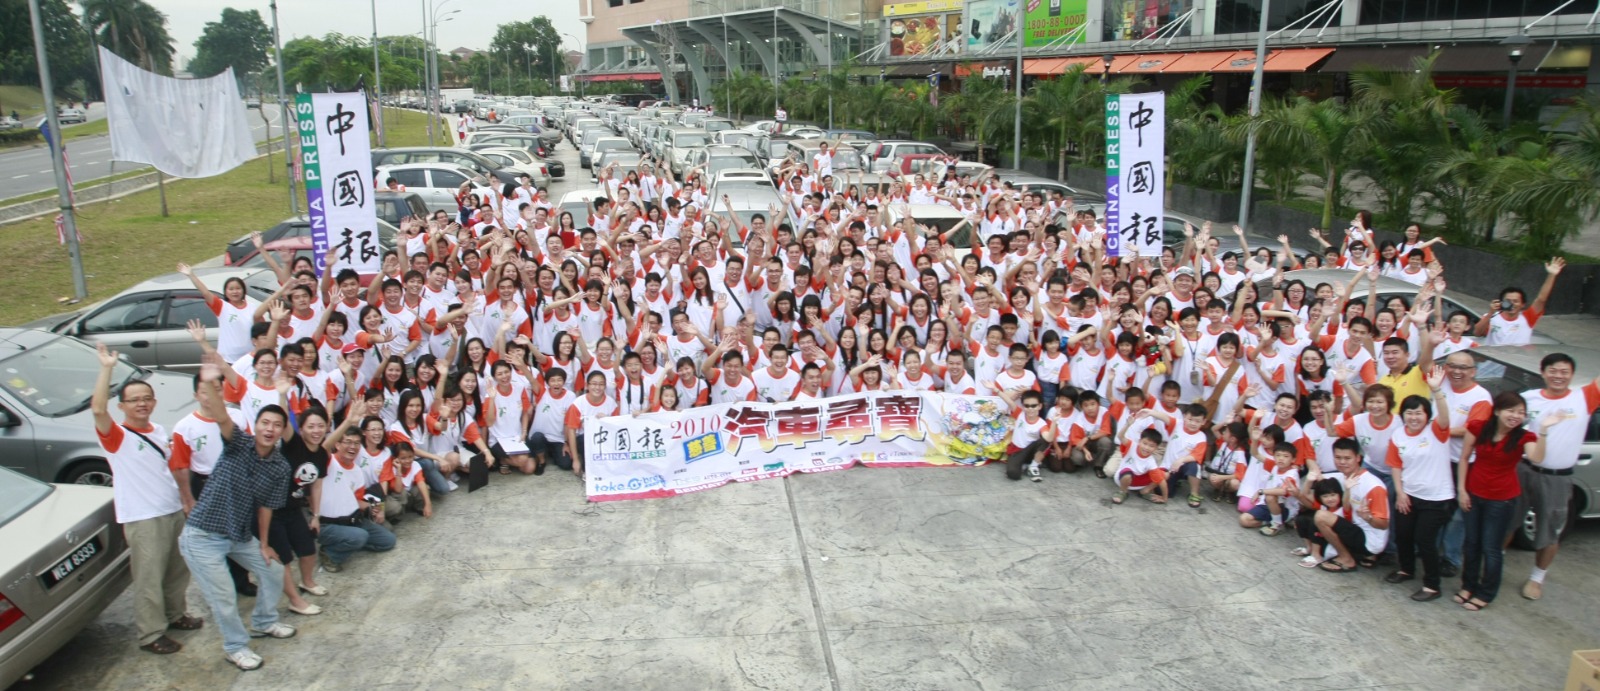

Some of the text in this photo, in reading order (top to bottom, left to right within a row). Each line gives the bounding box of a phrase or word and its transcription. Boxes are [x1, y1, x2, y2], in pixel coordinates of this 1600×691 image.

[298, 102, 320, 181] PRESS
[326, 103, 379, 264] 中國報
[1107, 100, 1119, 249] CHINA PRESS
[1120, 101, 1162, 246] 中國報
[593, 426, 665, 456] 中國報
[670, 414, 721, 439] 2010
[724, 395, 924, 456] 汽車尋寶
[593, 449, 666, 460] CHINA PRESS
[595, 482, 625, 492] take
[52, 542, 96, 580] WEW 8333
